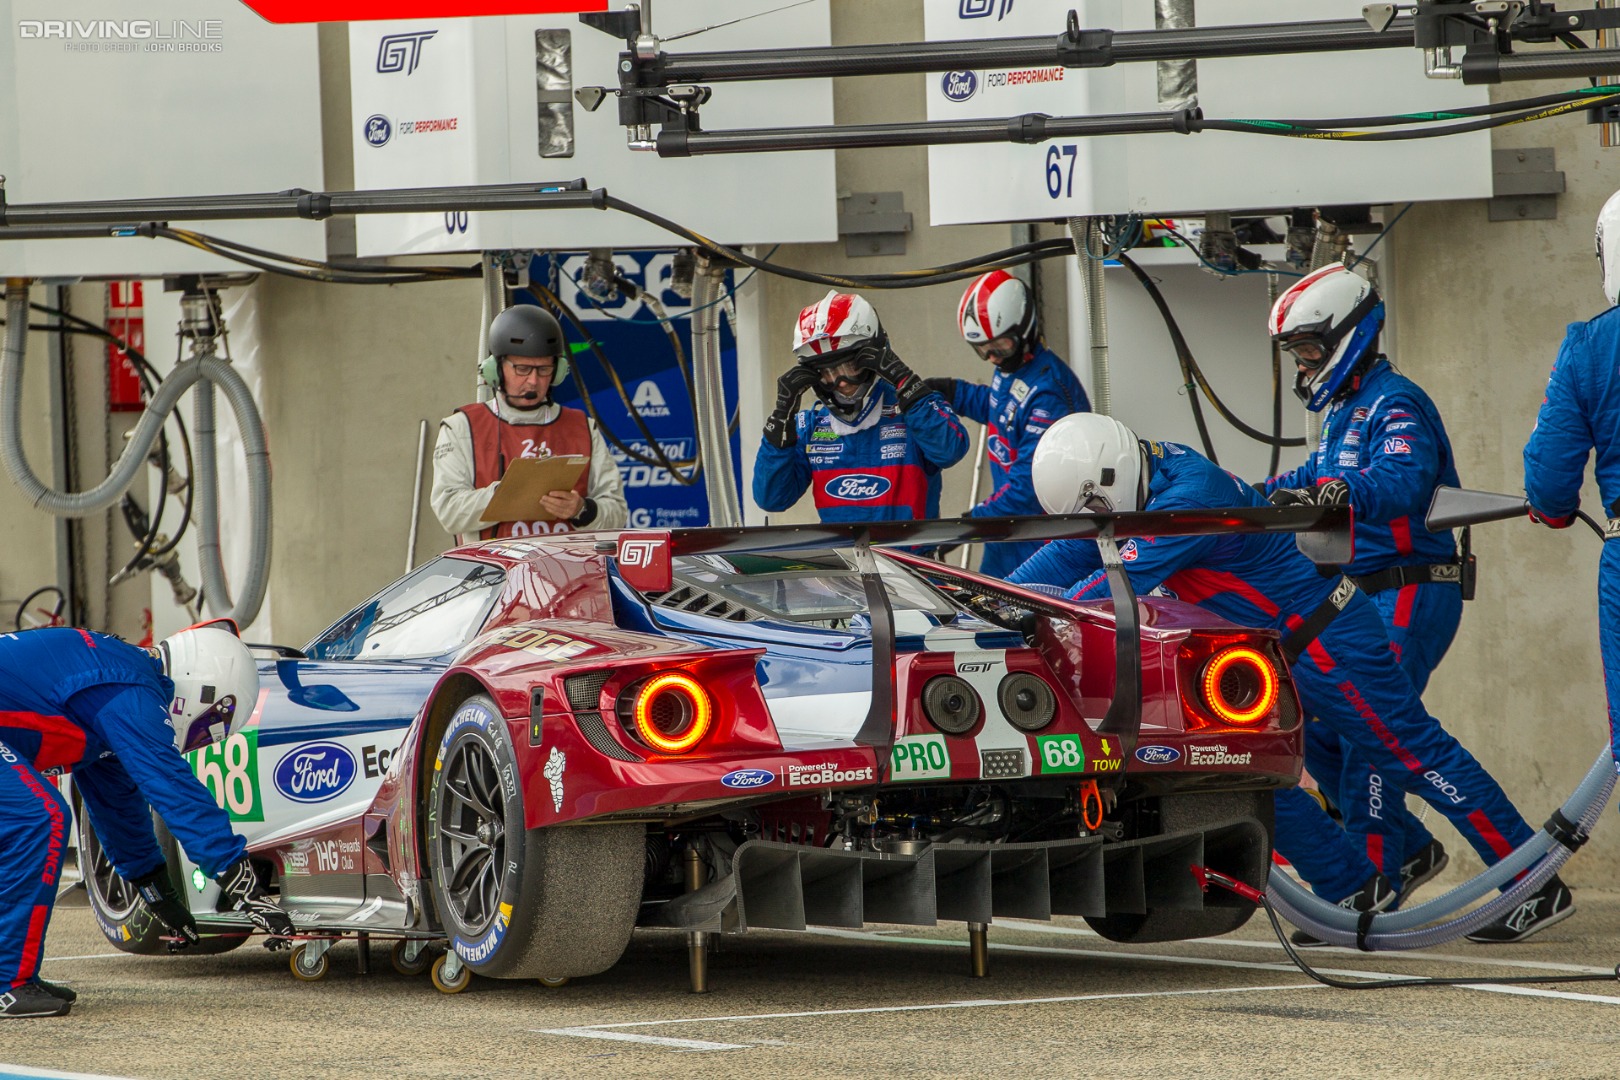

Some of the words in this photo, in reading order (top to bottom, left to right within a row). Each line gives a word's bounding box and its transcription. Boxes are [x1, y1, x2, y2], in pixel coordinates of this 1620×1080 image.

[376, 30, 438, 76] GT
[947, 70, 972, 95] Ford
[988, 73, 1006, 88] FORD
[1007, 67, 1064, 86] PERFORMANCE
[367, 119, 388, 142] Ford
[400, 122, 414, 134] FORD
[415, 117, 457, 133] PERFORMANCE
[1046, 144, 1077, 200] 67
[881, 452, 906, 460] EDGE
[837, 478, 878, 496] Ford
[656, 506, 699, 518] Rewards
[620, 540, 666, 569] GT
[957, 660, 1004, 673] GT
[445, 708, 487, 744] MICHELIN
[892, 741, 946, 773] PRO
[1043, 740, 1081, 768] 68
[1144, 747, 1172, 762] Ford
[1189, 744, 1219, 752] Powered
[1219, 745, 1228, 754] by
[1189, 751, 1252, 766] EcoBoost
[196, 732, 252, 816] 68
[291, 751, 341, 794] Ford
[731, 771, 764, 786] Ford
[788, 762, 827, 773] Powered
[827, 762, 838, 771] by
[789, 766, 873, 786] EcoBoost
[1092, 758, 1121, 771] TOW
[1369, 773, 1383, 820] FORD
[1423, 770, 1467, 804] FORD
[0, 741, 18, 763] RD
[11, 763, 65, 887] PERFORMANCE
[313, 840, 339, 871] IHG
[338, 837, 361, 854] Rewards
[341, 855, 354, 870] Club
[456, 928, 498, 962] MICHELIN
